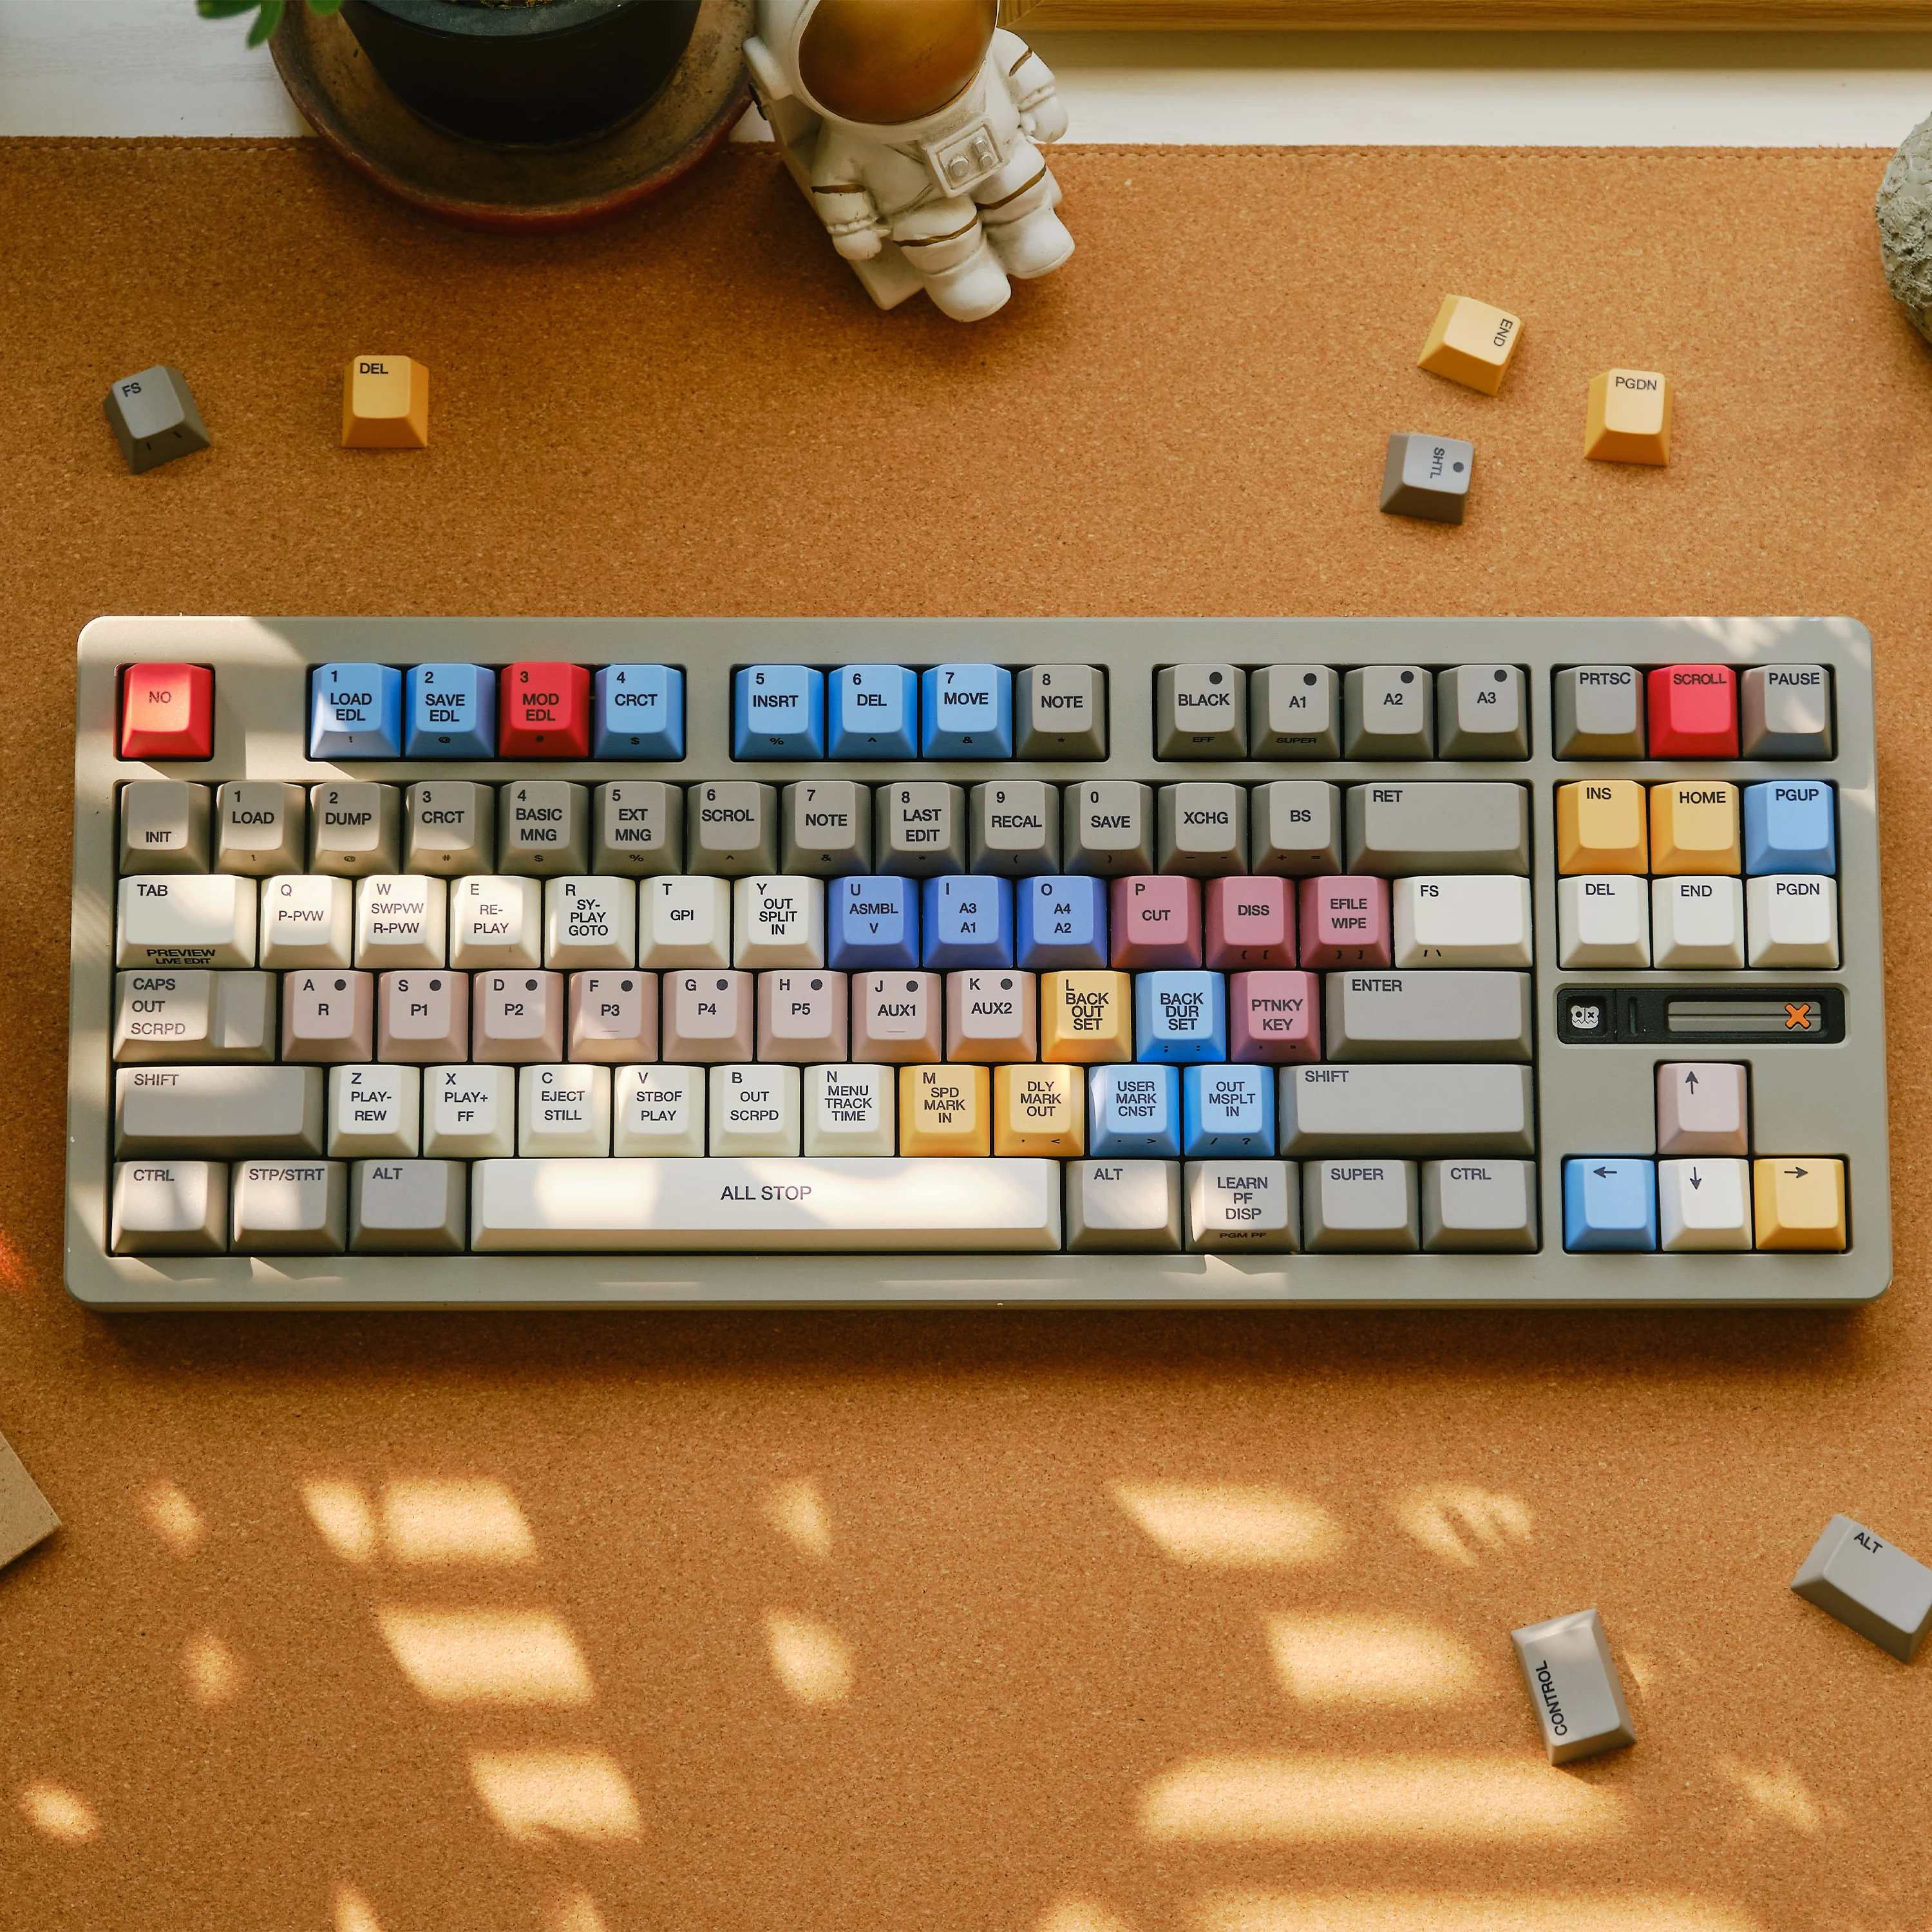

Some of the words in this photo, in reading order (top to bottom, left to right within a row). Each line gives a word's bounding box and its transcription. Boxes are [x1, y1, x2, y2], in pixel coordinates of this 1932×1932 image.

[1493, 318, 1513, 346] END
[359, 363, 388, 374] DEL
[1616, 376, 1657, 390] PGDN
[121, 382, 142, 397] FS
[1430, 446, 1445, 479] SHTL
[331, 670, 337, 682] 1
[616, 672, 625, 683] 4
[1042, 674, 1051, 686] 8
[1580, 672, 1631, 685] PRTSC
[1674, 674, 1727, 685] SCROLL
[1769, 672, 1820, 685] PAUSE
[149, 692, 171, 703] NO
[330, 692, 372, 705] LOAD
[425, 694, 465, 706] SAVE
[523, 693, 559, 706] MOD
[615, 694, 658, 706] CRCT
[753, 695, 799, 708] INSRT
[857, 694, 887, 706] DEL
[944, 692, 989, 705] MOVE
[1041, 696, 1083, 708] NOTE
[1179, 693, 1230, 706] BLACK
[1289, 696, 1306, 708] A1
[1383, 693, 1403, 705] A2
[1477, 692, 1496, 704] A3
[336, 708, 366, 721] EDL
[430, 710, 460, 722] EDL
[526, 709, 556, 721] EDL
[422, 791, 431, 803] 3
[807, 789, 816, 801] 7
[1090, 791, 1099, 803] 0
[1373, 790, 1403, 802] RET
[1586, 787, 1611, 800] INS
[1680, 791, 1726, 804] HOME
[1776, 788, 1819, 801] PGUP
[232, 811, 274, 824] LOAD
[325, 812, 372, 825] DUMP
[421, 811, 465, 824] CRCT
[516, 808, 562, 821] BASIC
[619, 808, 648, 820] EXT
[701, 809, 755, 822] SCROL
[806, 813, 848, 826] NOTE
[904, 809, 942, 822] LAST
[1184, 811, 1228, 824] XCHG
[1291, 810, 1311, 822] BS
[992, 815, 1042, 828] RECAL
[1091, 815, 1130, 828] SAVE
[146, 831, 172, 842] INIT
[520, 828, 556, 841] MNG
[616, 829, 651, 841] MNG
[906, 829, 940, 842] EDIT
[137, 884, 168, 896] TAB
[565, 884, 576, 896] R
[851, 884, 860, 896] U
[1135, 884, 1145, 896] P
[1421, 885, 1439, 897] FS
[1586, 884, 1615, 895] DEL
[1681, 885, 1712, 896] END
[1776, 883, 1819, 895] PGDN
[372, 903, 424, 914] SWPVW
[480, 904, 503, 914] RE-
[577, 899, 600, 910] SY-
[764, 898, 793, 909] OUT
[849, 903, 898, 914] ASMBL
[959, 903, 977, 914] A3
[1054, 904, 1071, 914] A4
[1331, 898, 1367, 909] EFILE
[279, 911, 323, 921] P-PVW
[670, 909, 694, 921] GPI
[759, 911, 797, 922] SPLIT
[1142, 910, 1171, 921] CUT
[1238, 905, 1269, 916] DISS
[571, 912, 606, 923] PLAY
[1331, 918, 1366, 929] WIPE
[374, 923, 419, 933] R-PVW
[474, 923, 509, 934] PLAY
[569, 925, 608, 936] GOTO
[772, 924, 784, 935] IN
[960, 922, 976, 933] A1
[1054, 922, 1071, 933] A2
[133, 978, 176, 990] CAPS
[398, 980, 408, 992] S
[780, 978, 790, 990] H
[1066, 979, 1075, 991] L
[1352, 979, 1402, 992] ENTER
[1066, 992, 1109, 1005] BACK
[1160, 992, 1204, 1005] BACK
[132, 1000, 166, 1012] OUT
[411, 1004, 427, 1016] P1
[505, 1003, 524, 1016] P2
[601, 1004, 620, 1016] P3
[698, 1003, 717, 1015] P4
[792, 1003, 810, 1015] P5
[878, 1004, 916, 1016] AUX1
[971, 1002, 1012, 1014] AUX2
[1252, 999, 1303, 1011] PTNKY
[1072, 1005, 1104, 1018] OUT
[1166, 1005, 1199, 1018] DUR
[131, 1023, 185, 1034] SCRPD
[1074, 1018, 1103, 1030] SET
[1168, 1018, 1197, 1030] SET
[1263, 1019, 1293, 1030] KEY
[134, 1074, 179, 1086] SHIFT
[638, 1072, 649, 1084] V
[923, 1072, 936, 1084] M
[1305, 1070, 1349, 1082] SHIFT
[828, 1085, 868, 1096] MENU
[931, 1087, 959, 1098] SPD
[1028, 1081, 1054, 1092] DLY
[1117, 1081, 1155, 1092] USER
[1216, 1081, 1245, 1092] OUT
[351, 1092, 392, 1102] PLAY-
[444, 1092, 488, 1103] PLAY+
[542, 1091, 585, 1101] EJECT
[636, 1091, 682, 1102] STBOF
[740, 1091, 770, 1102] OUT
[1021, 1094, 1061, 1104] MARK
[1116, 1094, 1157, 1104] MARK
[1209, 1094, 1256, 1104] MSPLT
[824, 1097, 872, 1108] TRACK
[924, 1099, 965, 1110] MARK
[355, 1110, 387, 1121] REW
[458, 1111, 474, 1122] FF
[544, 1110, 582, 1121] STILL
[641, 1110, 676, 1121] PLAY
[730, 1110, 779, 1121] SCRPD
[831, 1110, 866, 1121] TIME
[938, 1112, 952, 1123] IN
[1027, 1106, 1056, 1117] OUT
[1118, 1106, 1155, 1117] CNST
[1226, 1106, 1239, 1117] IN
[133, 1170, 175, 1181] CTRL
[249, 1168, 325, 1181] STP/STRT
[372, 1168, 403, 1180] ALT
[1094, 1168, 1123, 1180] ALT
[1331, 1168, 1383, 1180] SUPER
[1450, 1168, 1492, 1180] CTRL
[1217, 1177, 1267, 1189] LEARN
[721, 1186, 756, 1200] ALL
[761, 1186, 811, 1200] STOP
[1233, 1193, 1253, 1204] PF
[1226, 1208, 1262, 1220] DISP
[1853, 1532, 1883, 1554] ALT
[1536, 1660, 1567, 1736] CONTROL
